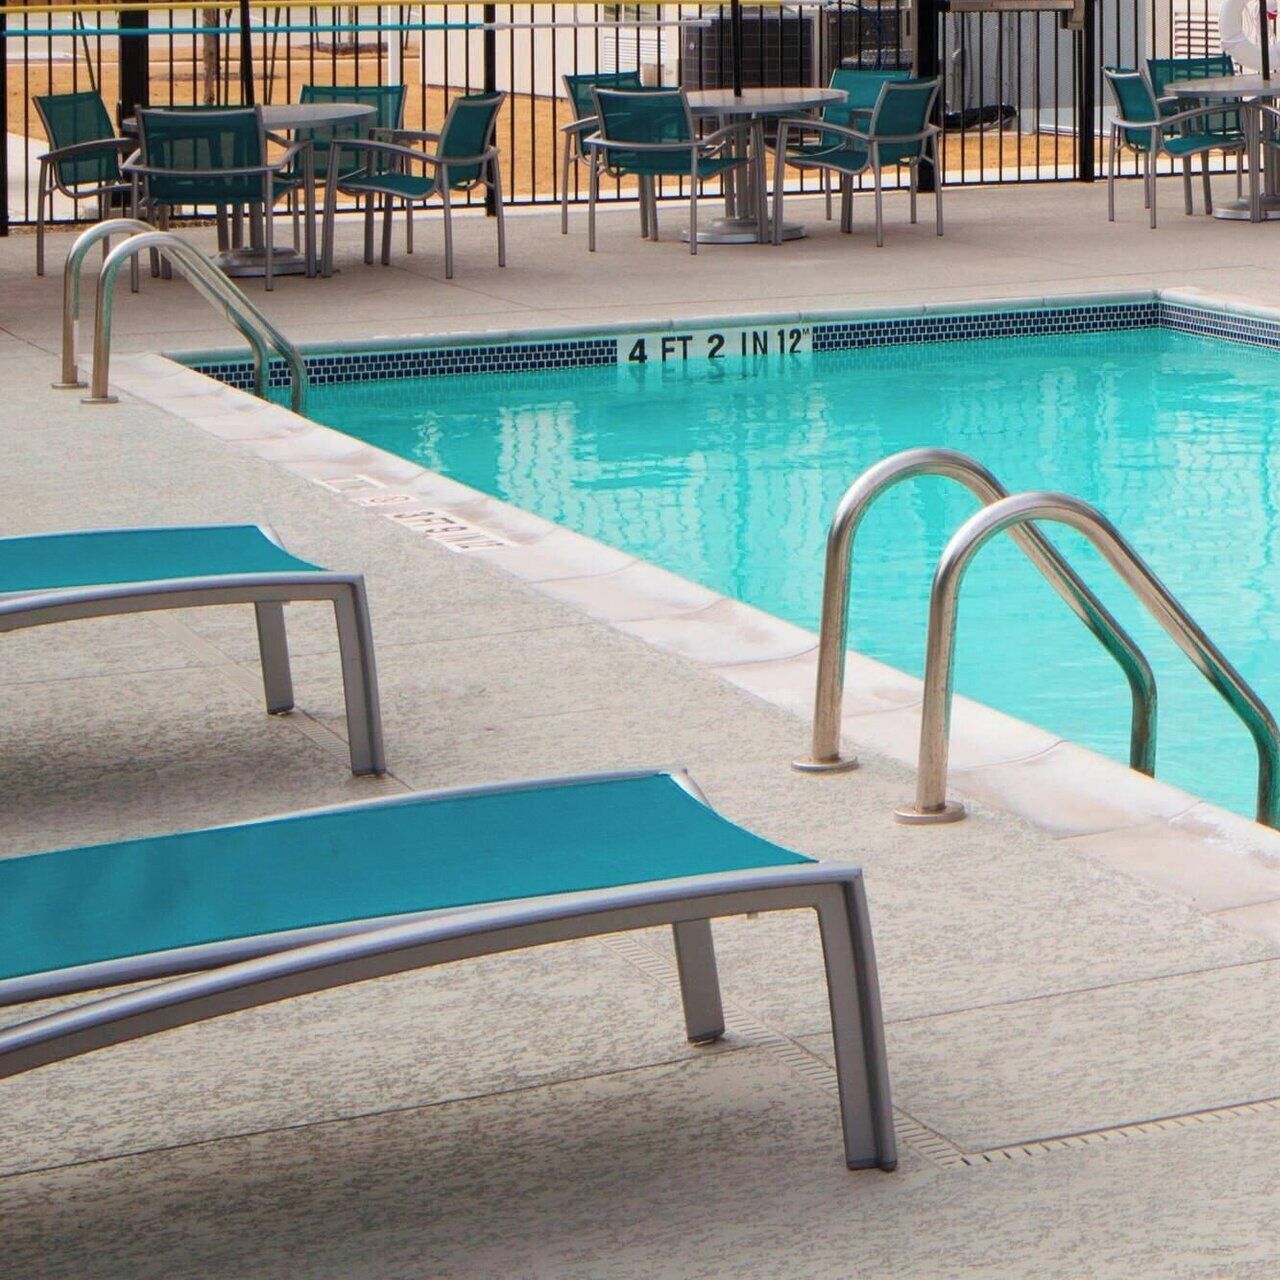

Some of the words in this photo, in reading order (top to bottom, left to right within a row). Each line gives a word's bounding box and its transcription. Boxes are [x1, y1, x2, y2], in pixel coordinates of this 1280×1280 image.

[628, 338, 648, 363] 4
[661, 334, 693, 361] FT
[707, 333, 726, 358] 2
[741, 330, 768, 356] IN
